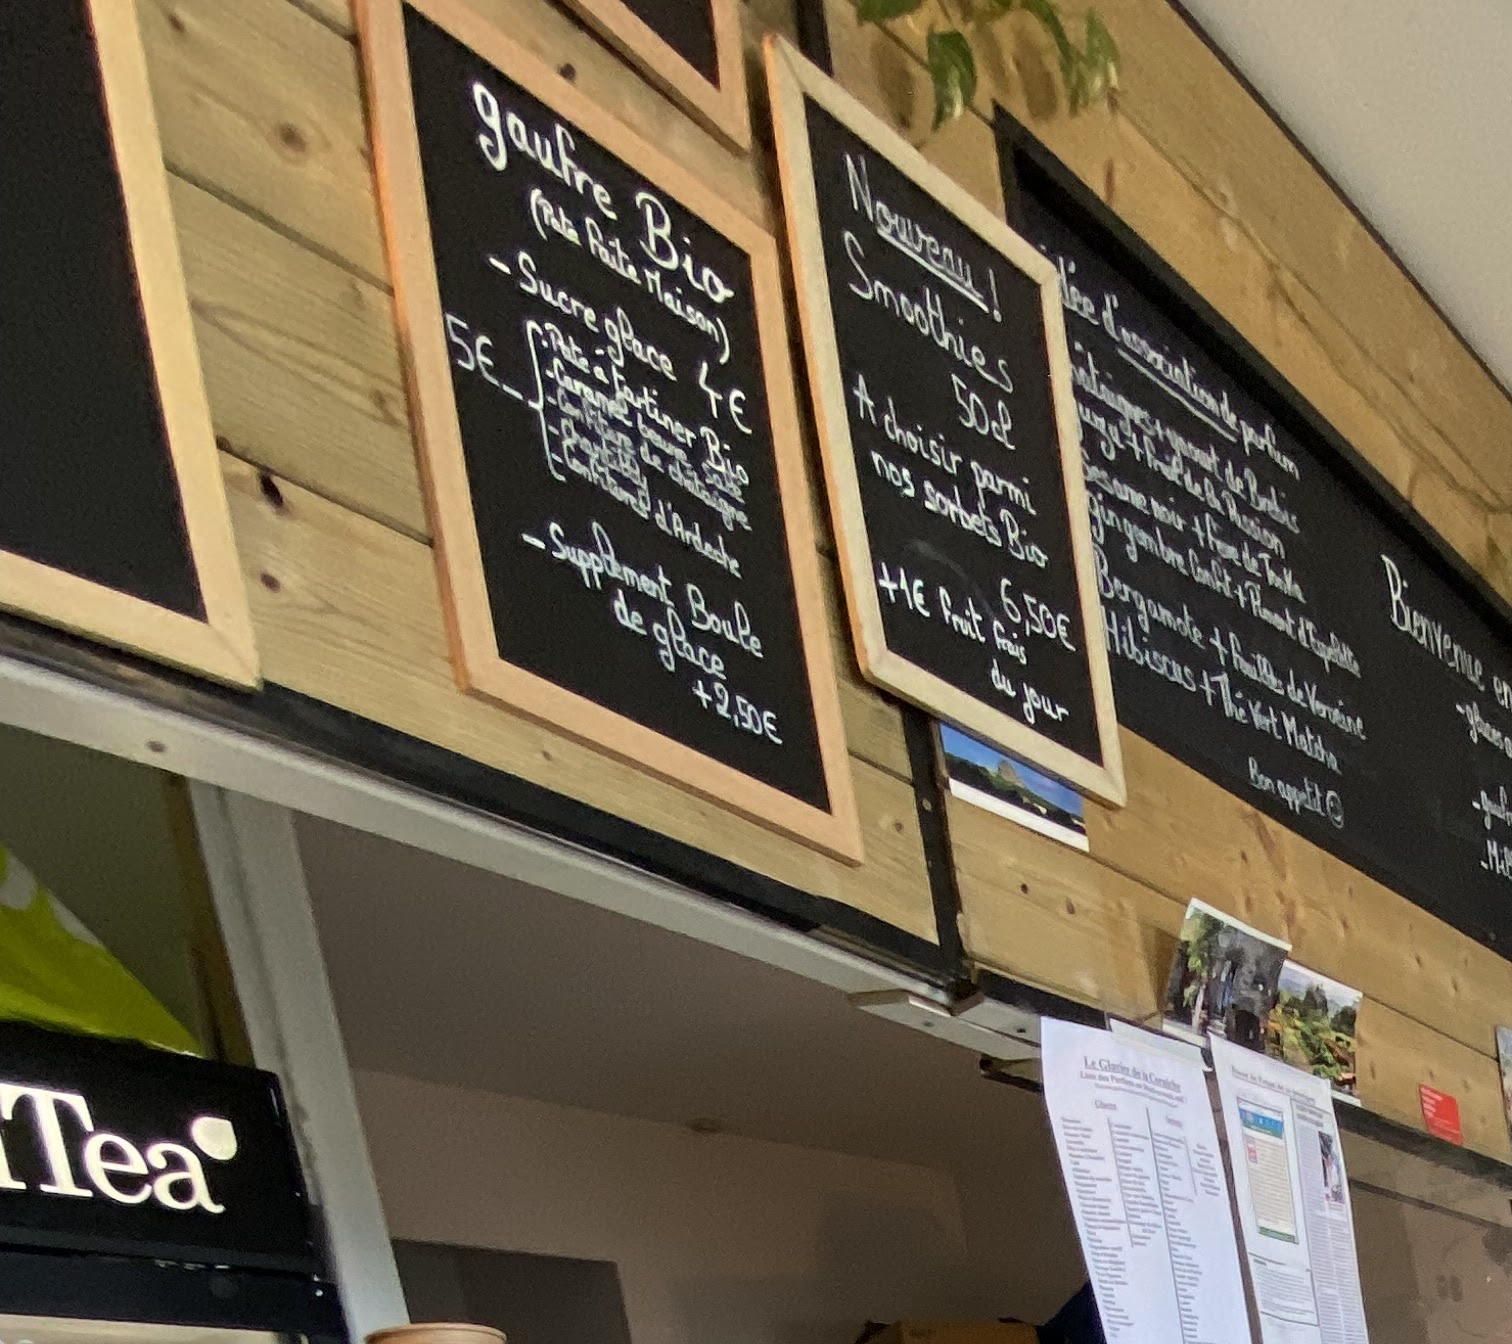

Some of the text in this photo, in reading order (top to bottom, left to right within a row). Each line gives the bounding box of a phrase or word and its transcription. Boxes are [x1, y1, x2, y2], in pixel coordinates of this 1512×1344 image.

[636, 192, 734, 303] Bio
[605, 307, 677, 381] glace
[843, 230, 1014, 393] Smoothies
[700, 426, 749, 486] Bio
[853, 373, 1037, 516] A choisir parmi
[871, 450, 1049, 568] nos sorbets Bio
[613, 588, 727, 680] de glace
[686, 582, 764, 658] Boule
[1381, 552, 1486, 692] Bienvenue
[1023, 681, 1070, 725] jour
